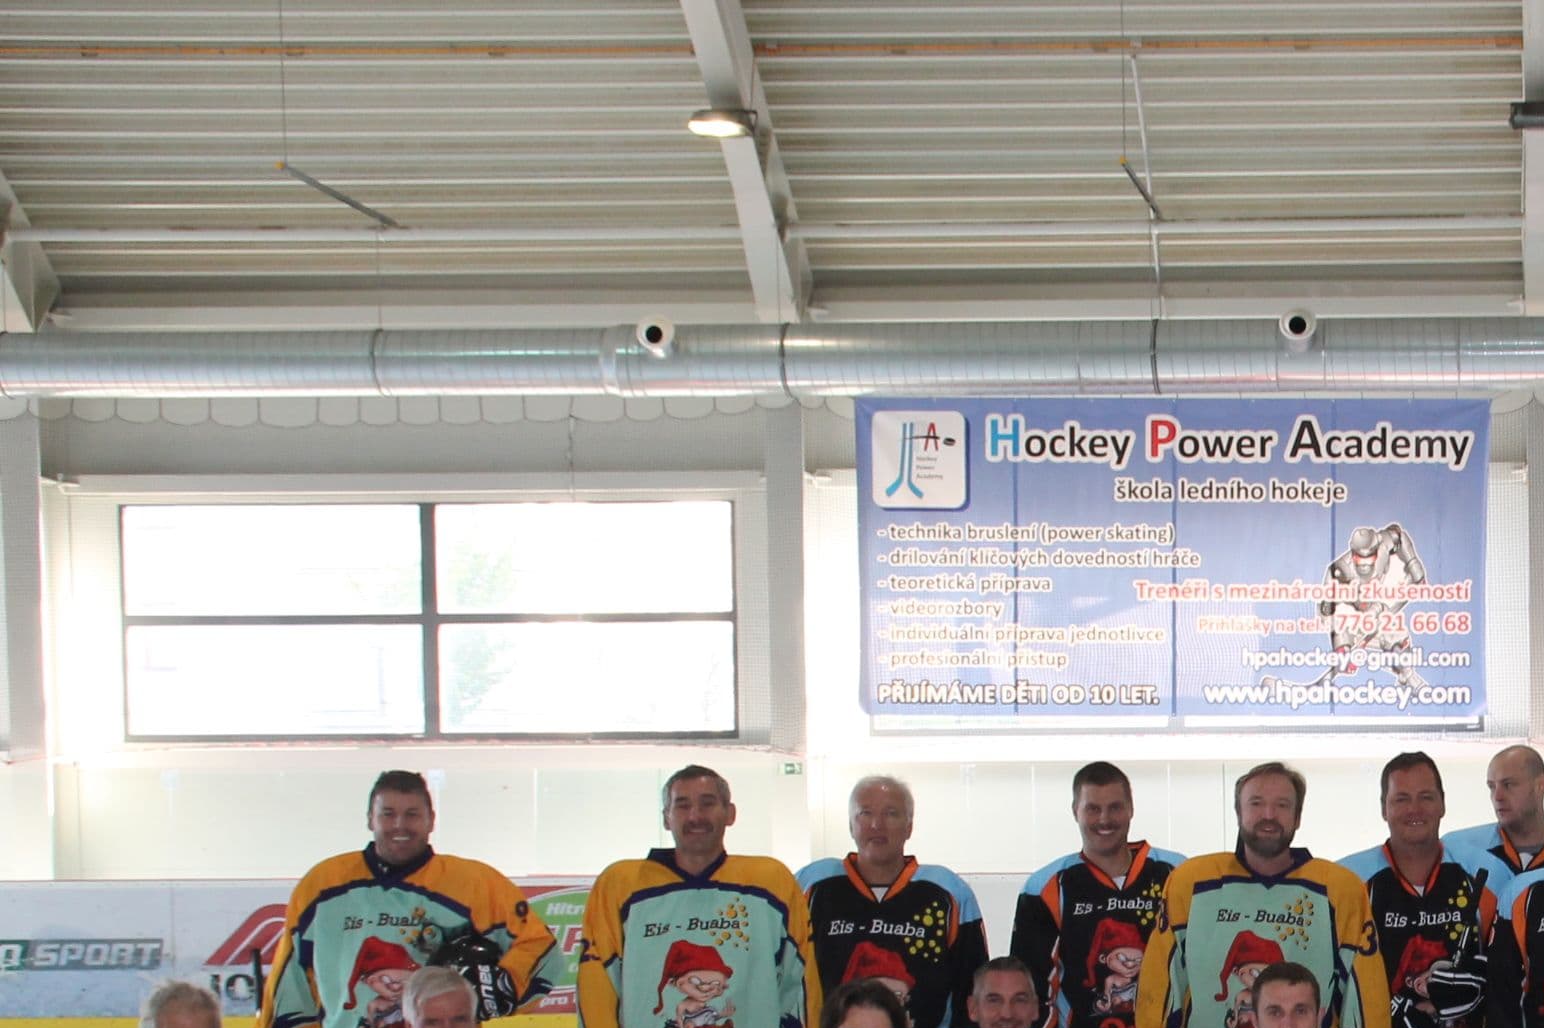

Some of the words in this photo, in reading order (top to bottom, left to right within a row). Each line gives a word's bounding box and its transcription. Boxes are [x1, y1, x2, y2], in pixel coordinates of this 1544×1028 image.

[990, 418, 1131, 465] Hockey
[1150, 419, 1274, 458] Power
[1288, 419, 1470, 465] Academy
[1116, 479, 1174, 500] škola
[1180, 480, 1264, 500] ledního
[1271, 480, 1346, 504] hokeje
[890, 525, 962, 541] technika
[967, 525, 1036, 540] bruslení
[1040, 525, 1102, 544] (power
[1107, 524, 1175, 544] skating)
[890, 549, 965, 566] drilování
[1053, 549, 1148, 566] dovedností
[1153, 549, 1200, 567] hráče
[890, 575, 976, 592] teoretická
[980, 575, 1051, 594] příprava
[1213, 586, 1224, 601] s
[1230, 581, 1358, 601] mezinárodní
[1362, 580, 1471, 601] zkušeností
[890, 601, 1003, 618] videorozbory
[1275, 620, 1296, 633] na
[1337, 613, 1377, 633] 776
[1381, 613, 1406, 633] 21
[1411, 613, 1438, 633] 66
[1442, 613, 1471, 633] 68
[1069, 626, 1165, 645] jednotlivce
[1241, 647, 1471, 671] hpahockey@gmail.com
[877, 680, 996, 704] PŘIJÍMÁME
[1000, 680, 1048, 704] DĚTI
[1051, 684, 1086, 704] OD
[1089, 684, 1116, 704] 10
[1118, 684, 1161, 704] LET.
[1203, 679, 1472, 709] www.hpahockey.com
[1106, 897, 1154, 912] Buaba
[643, 922, 671, 938] Eis
[687, 917, 741, 931] Buaba
[1216, 908, 1241, 923] Eis
[1254, 909, 1305, 927] Buaba
[1384, 912, 1408, 928] Eis
[827, 919, 855, 936] Eis
[869, 919, 926, 938] Buaba
[33, 942, 163, 967] SPORT
